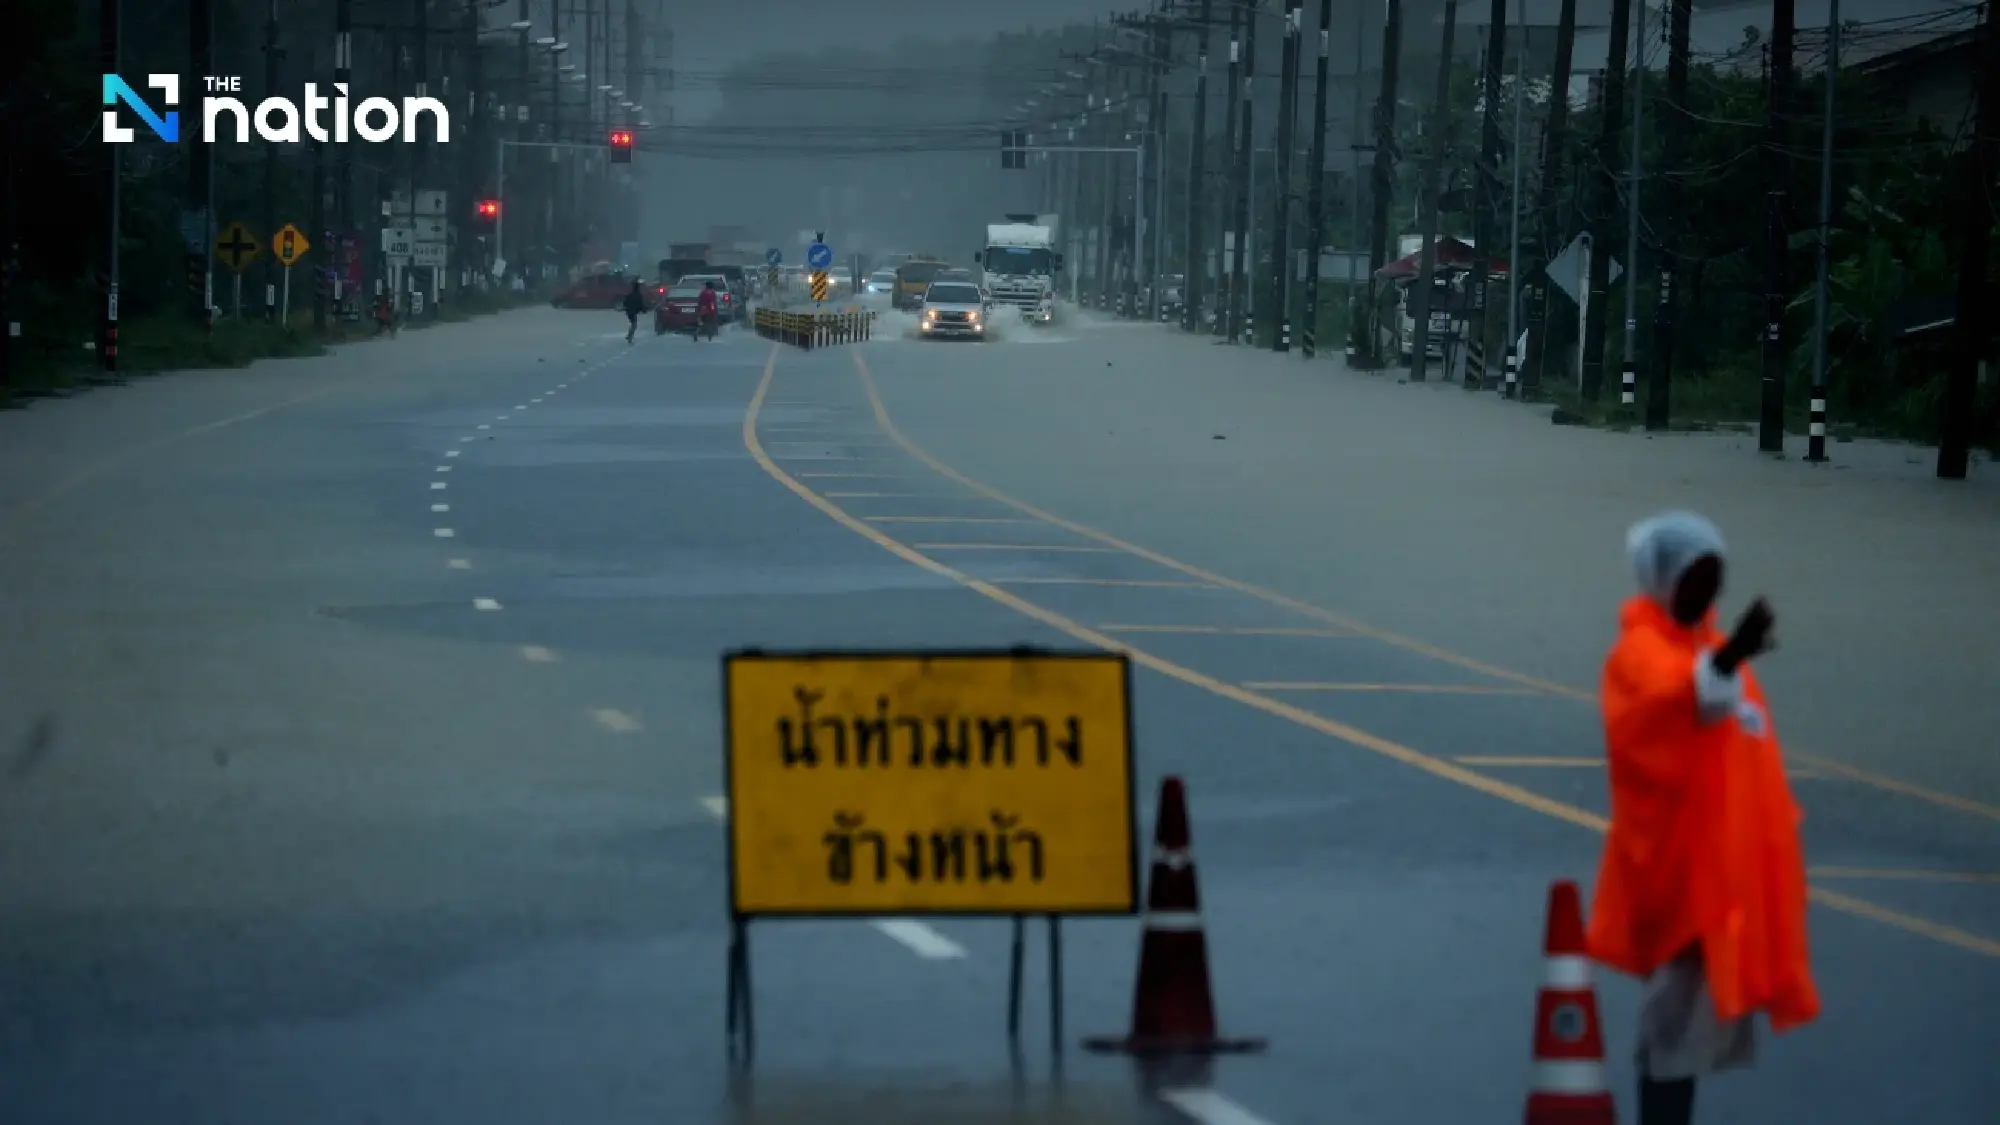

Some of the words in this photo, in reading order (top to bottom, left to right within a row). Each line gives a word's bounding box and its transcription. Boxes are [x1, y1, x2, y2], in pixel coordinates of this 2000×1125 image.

[778, 687, 1084, 768] น้ำท่วมทาง
[822, 809, 1046, 884] ข้างหน้า
